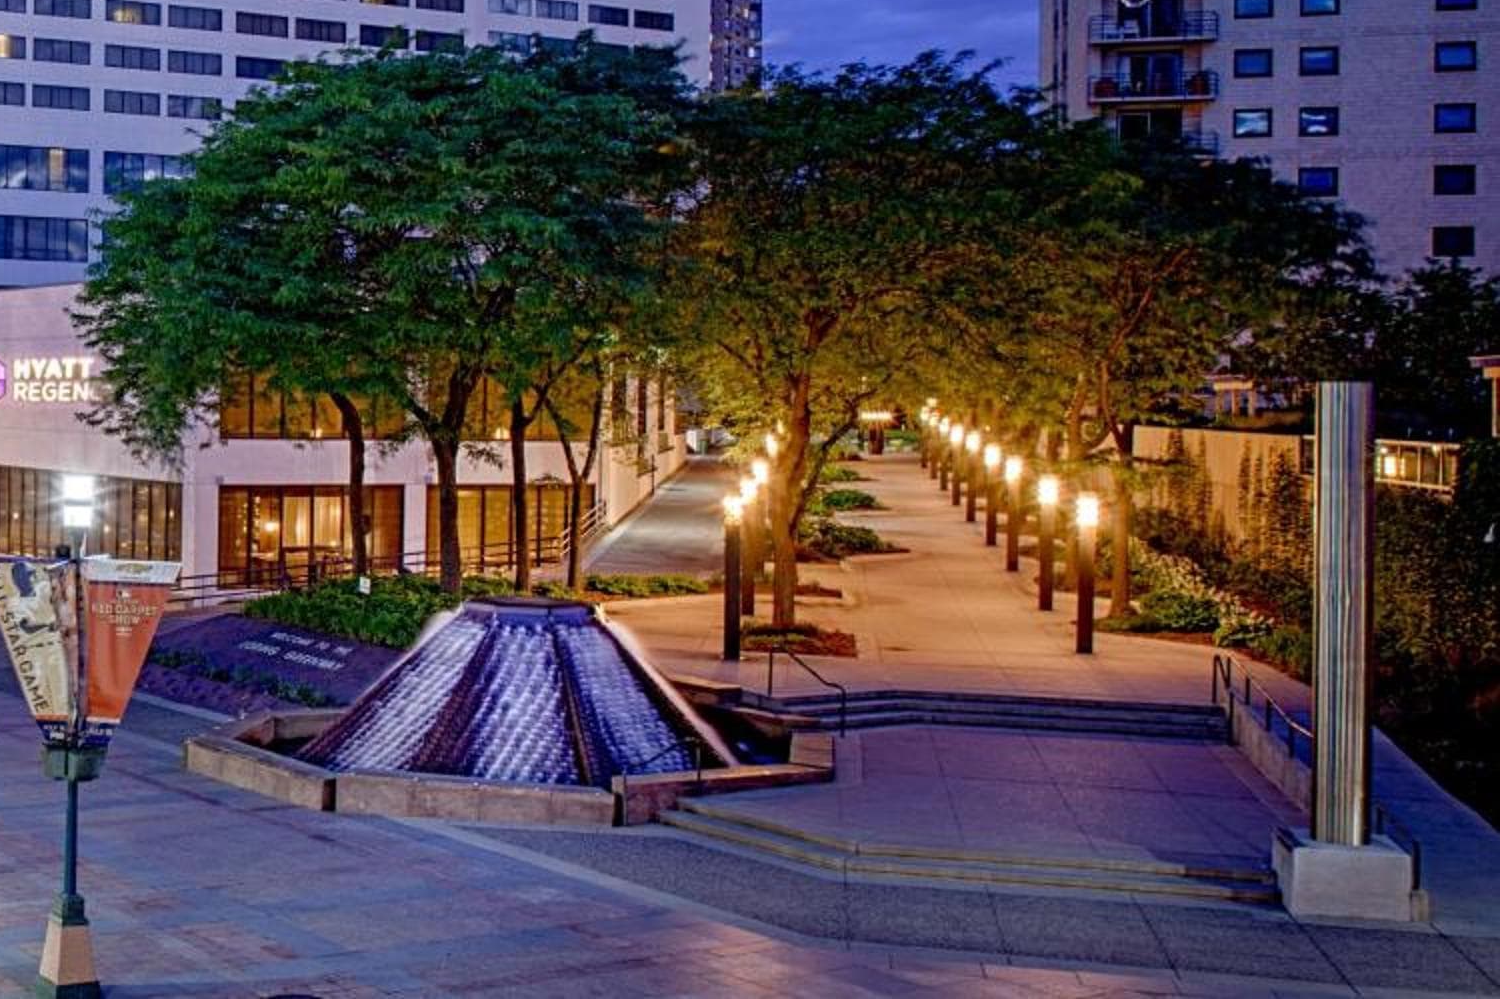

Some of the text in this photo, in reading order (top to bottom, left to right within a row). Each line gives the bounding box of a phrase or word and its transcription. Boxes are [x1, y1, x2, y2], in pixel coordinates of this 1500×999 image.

[12, 358, 95, 379] HYATT
[12, 382, 108, 402] REGENC
[1, 611, 27, 658] STAR
[20, 659, 49, 712] GAME
